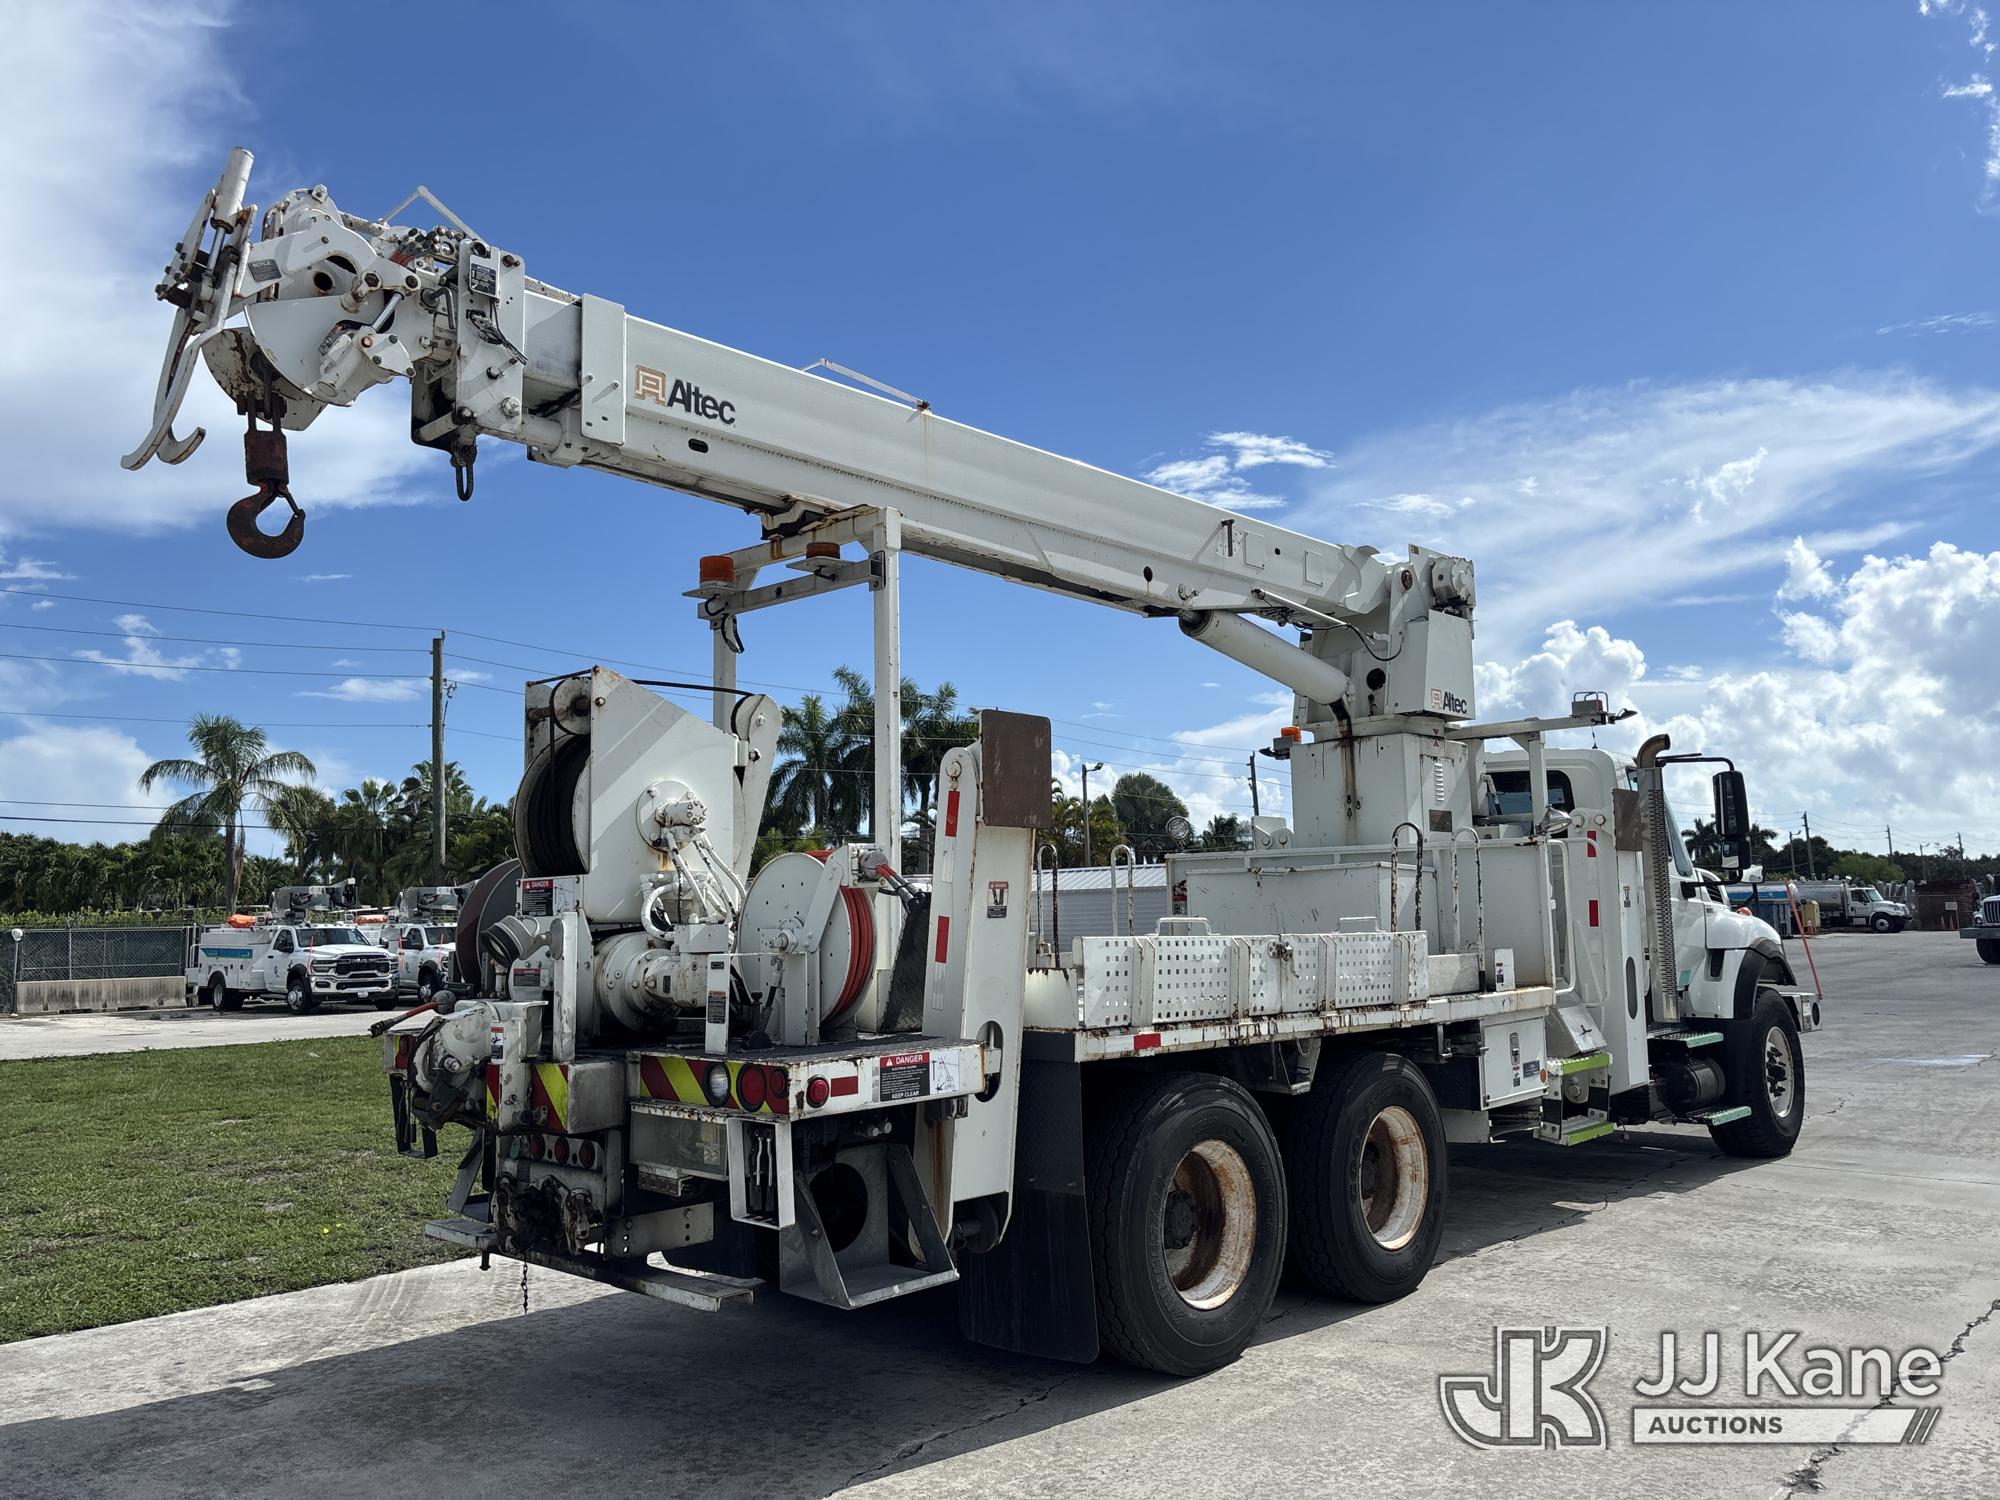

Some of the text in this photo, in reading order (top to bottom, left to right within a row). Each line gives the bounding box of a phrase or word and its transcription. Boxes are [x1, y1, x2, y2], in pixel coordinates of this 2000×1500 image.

[667, 378, 736, 425] Altec
[1443, 691, 1467, 714] Altec
[531, 880, 550, 888] DANGER
[895, 1054, 924, 1065] DANGER
[904, 1090, 920, 1098] CLEAR
